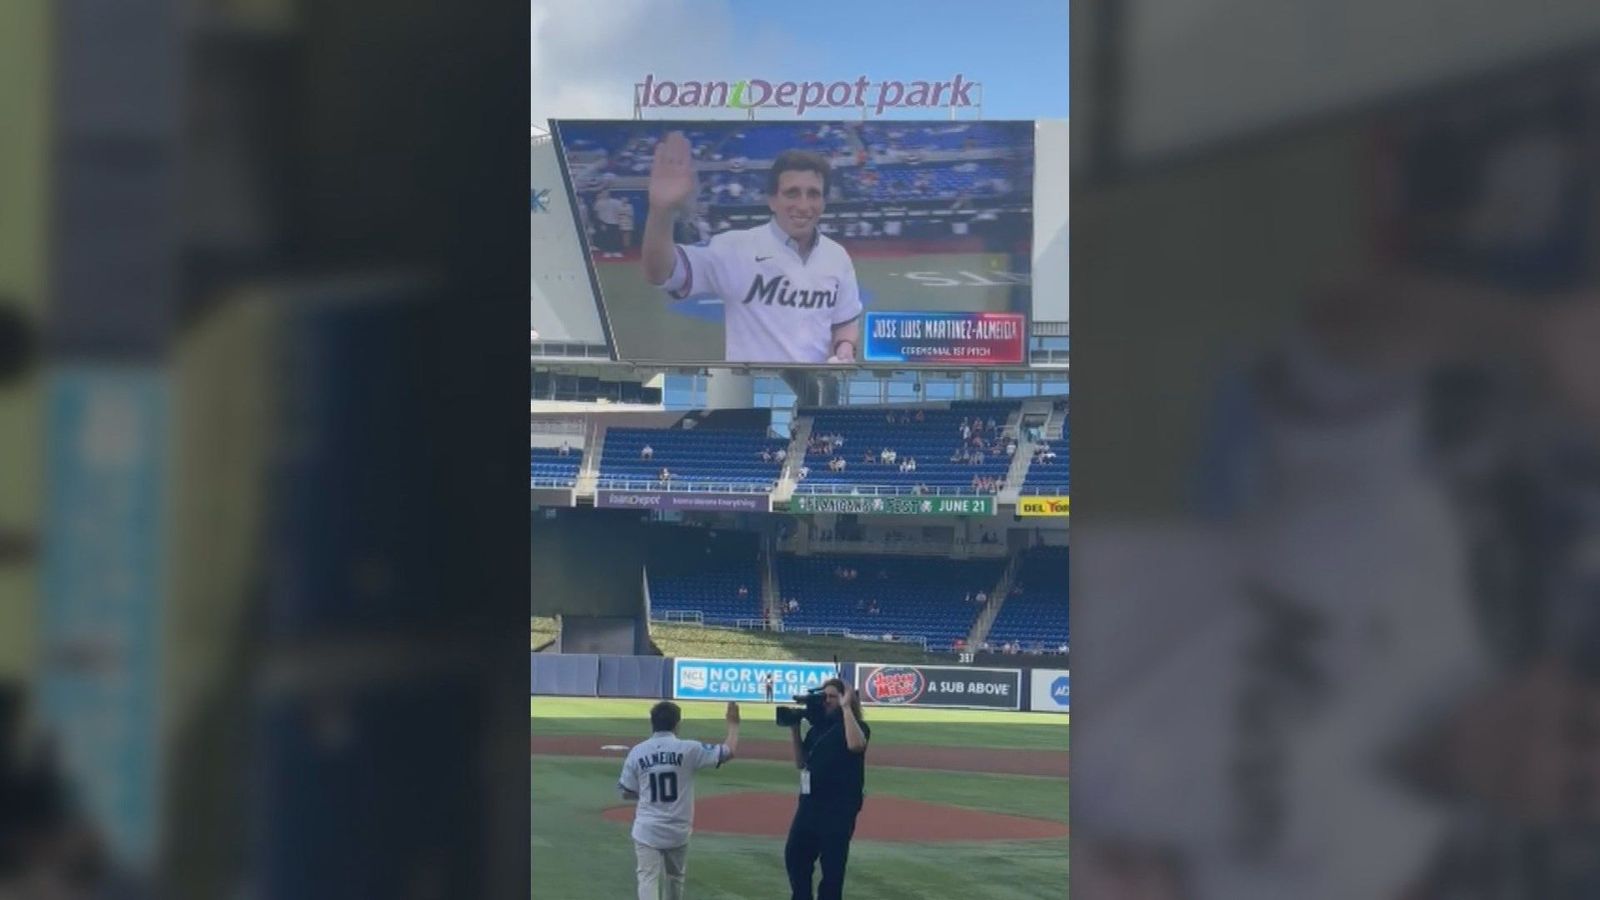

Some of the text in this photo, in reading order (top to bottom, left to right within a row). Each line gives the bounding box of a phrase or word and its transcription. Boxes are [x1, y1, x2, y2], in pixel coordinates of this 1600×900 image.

[640, 74, 975, 115] loanDepot park
[742, 274, 840, 308] Miami
[873, 319, 897, 339] JOSE
[900, 319, 922, 339] LUIS
[967, 347, 991, 356] PITCH
[939, 500, 969, 512] JUNE
[972, 500, 986, 512] 21
[1023, 504, 1046, 512] DEL
[710, 668, 838, 683] NORWEGIAN
[709, 681, 766, 694] CRUISE
[928, 681, 1009, 695] A SUB ABOVE
[649, 771, 678, 803] 10
